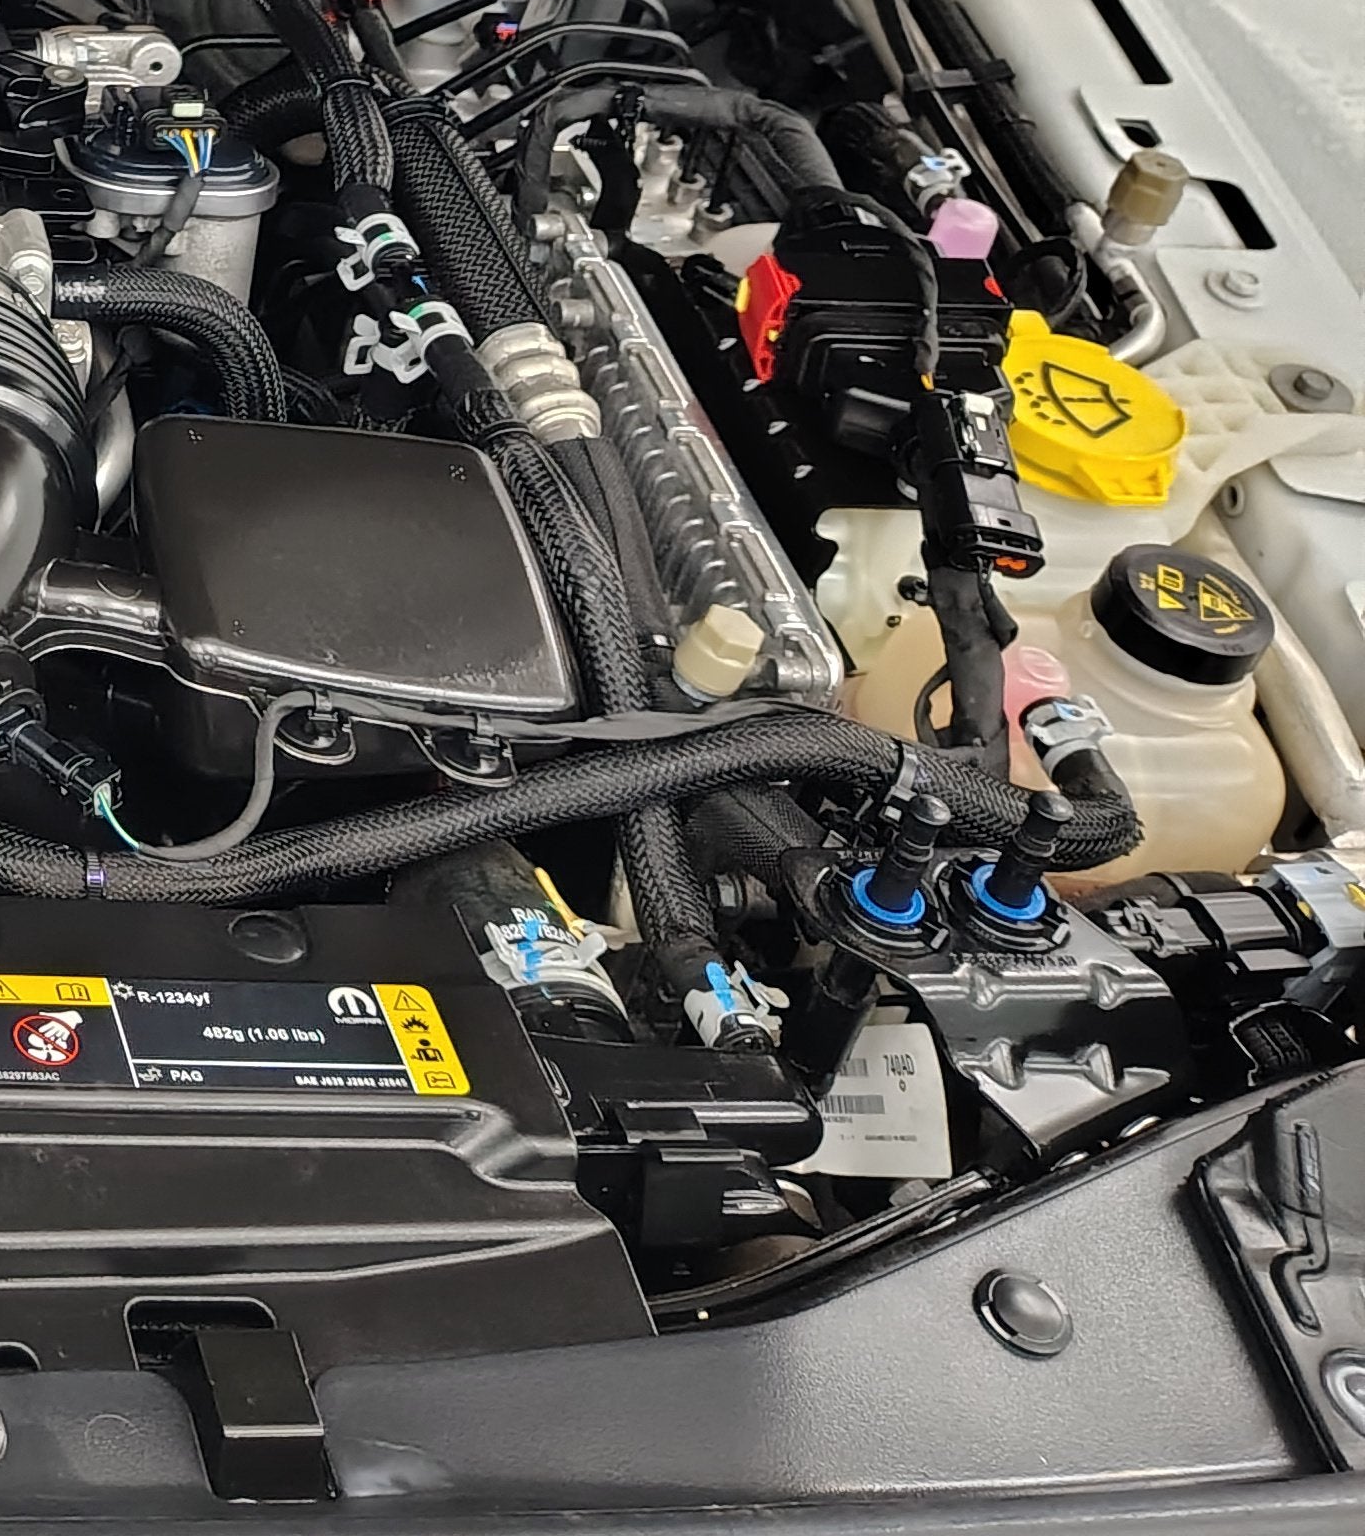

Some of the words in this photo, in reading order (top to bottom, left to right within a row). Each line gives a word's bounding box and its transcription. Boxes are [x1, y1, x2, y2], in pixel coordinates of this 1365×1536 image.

[510, 907, 549, 924] RAD
[137, 992, 210, 1007] R-1234yf
[202, 1026, 244, 1042] 482g
[169, 1069, 203, 1082] PAG
